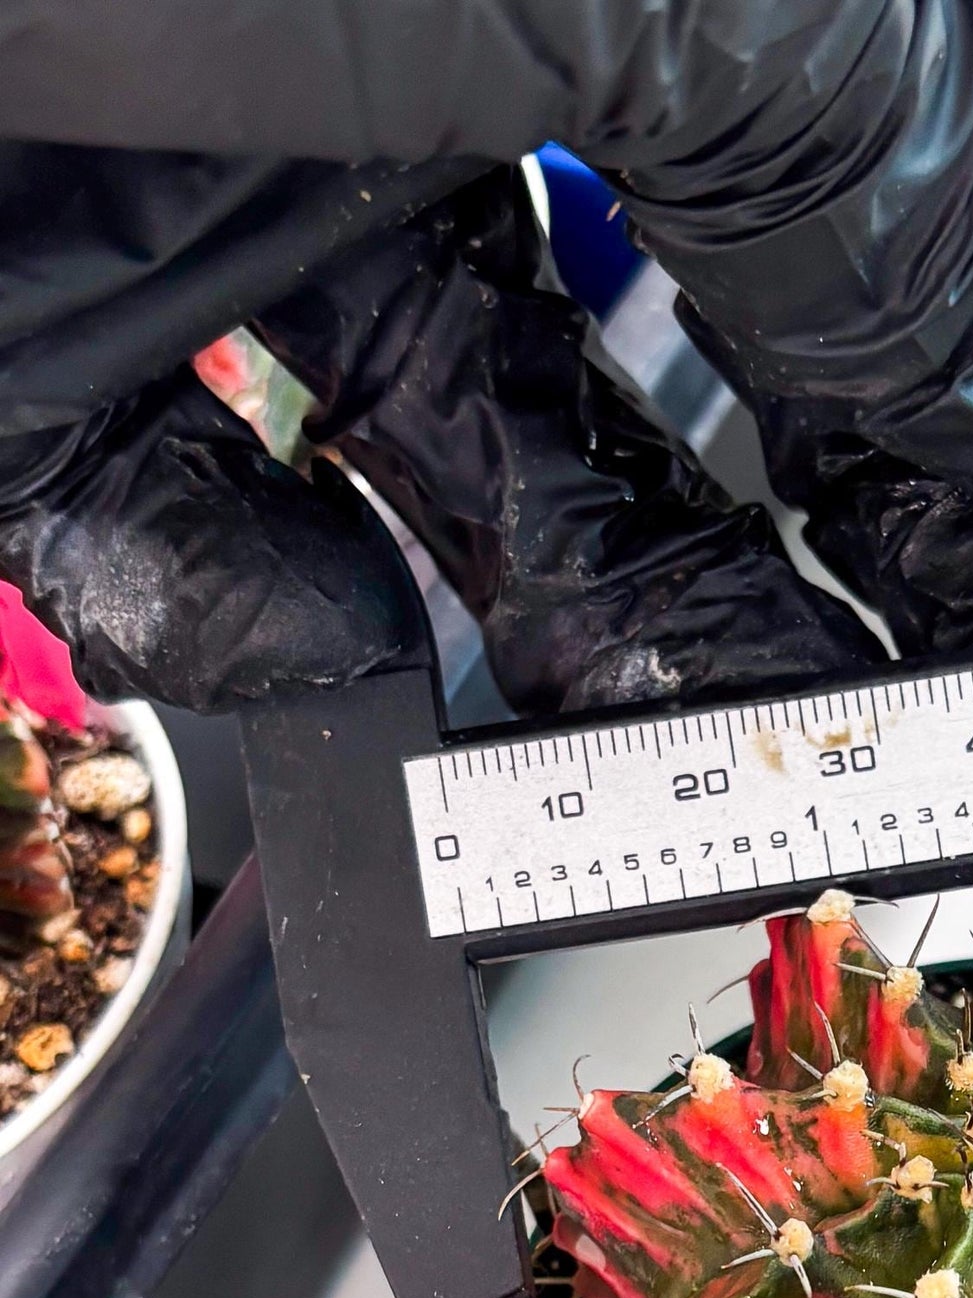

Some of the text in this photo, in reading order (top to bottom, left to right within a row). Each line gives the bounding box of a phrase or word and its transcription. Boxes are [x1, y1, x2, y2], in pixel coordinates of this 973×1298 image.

[434, 834, 461, 862] 0
[541, 791, 584, 821] 10
[672, 768, 730, 802] 20
[819, 745, 876, 777] 30
[485, 876, 494, 893] 1
[514, 870, 532, 888] 2
[550, 864, 568, 881] 3
[587, 859, 603, 876] 4
[623, 853, 640, 871] 5
[660, 848, 677, 866] 6
[700, 842, 714, 859] 7
[732, 836, 751, 854] 8
[770, 830, 788, 849] 9
[804, 805, 818, 832] 1
[851, 818, 860, 835] 1
[880, 813, 898, 831] 2
[917, 807, 934, 824] 3
[954, 801, 970, 818] 4
